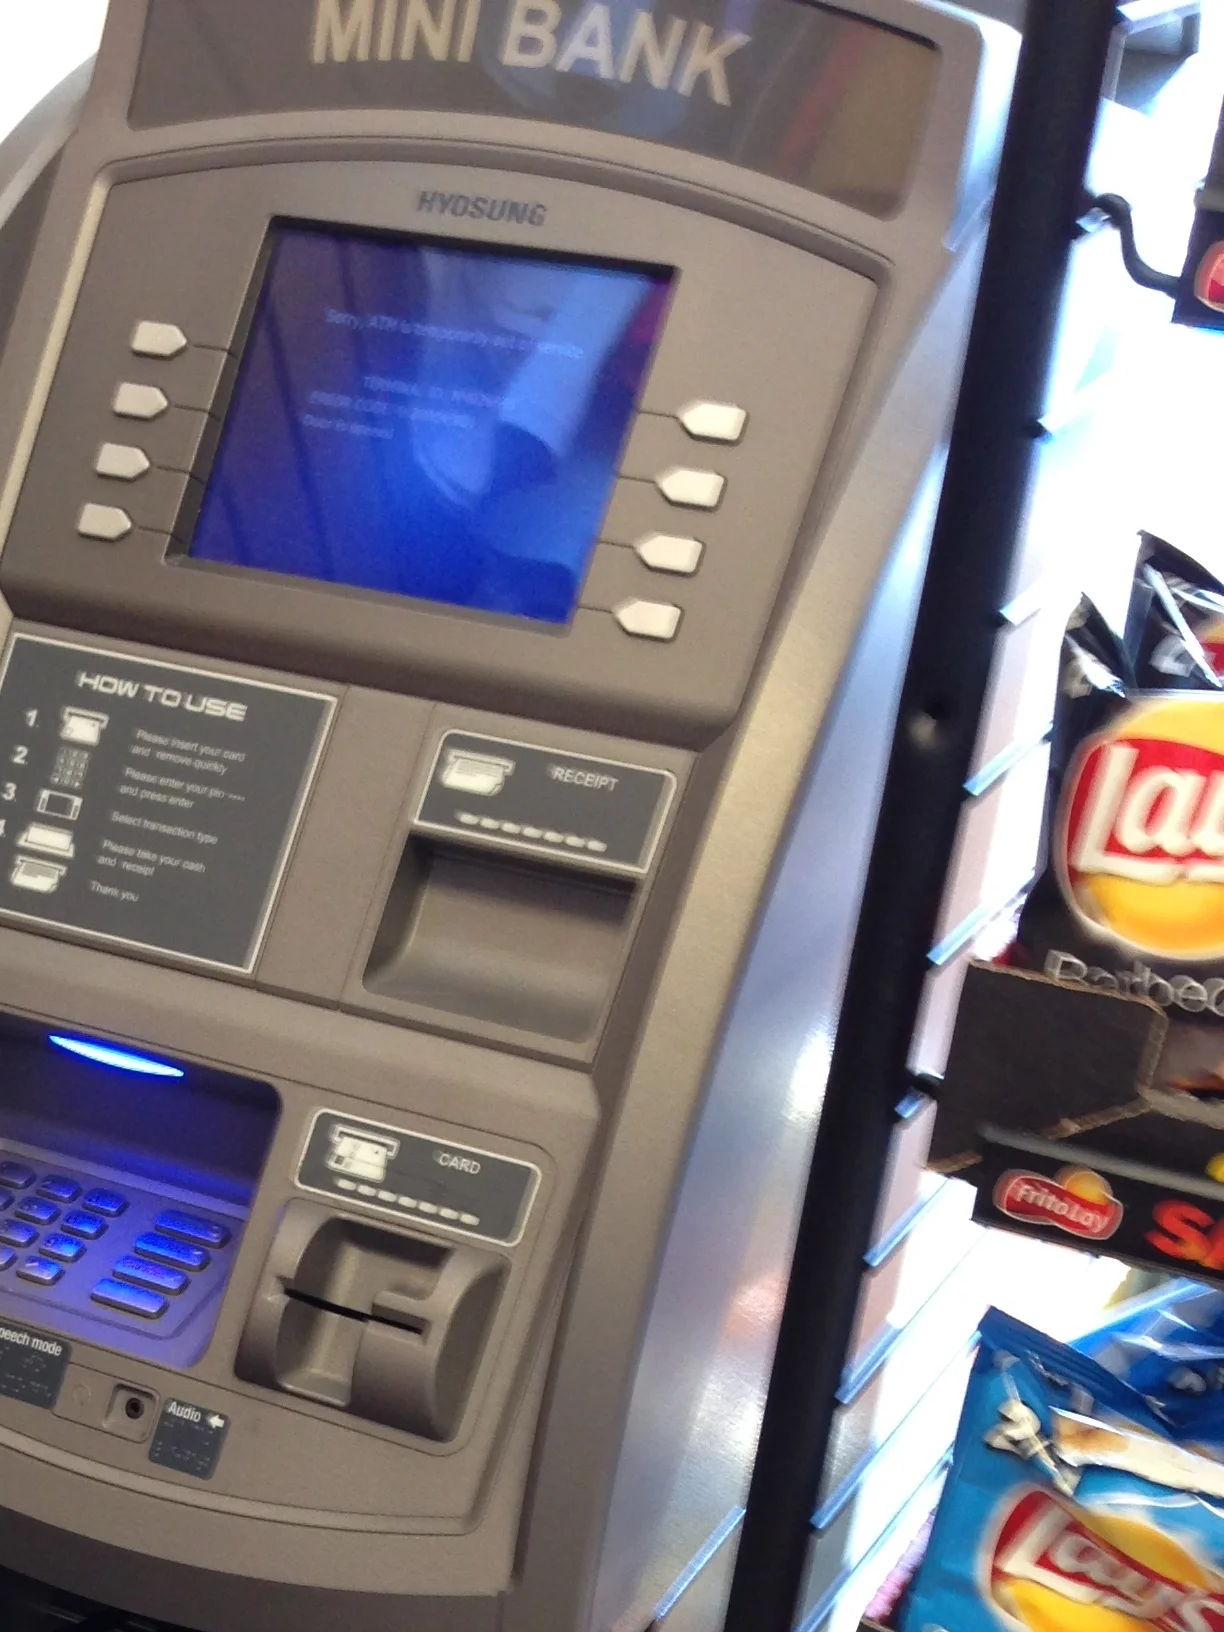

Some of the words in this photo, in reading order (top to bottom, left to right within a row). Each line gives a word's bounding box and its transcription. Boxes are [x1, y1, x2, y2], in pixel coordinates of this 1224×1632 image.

[311, 0, 479, 64] MINI
[502, 0, 752, 107] BANK
[417, 189, 548, 228] HYOSUNG
[78, 671, 140, 699] HOW
[144, 684, 182, 708] TO
[184, 693, 248, 722] USE
[552, 765, 619, 792] RECEIPT
[111, 810, 142, 827] Select
[90, 879, 120, 897] Thank
[120, 890, 140, 903] you
[437, 1152, 481, 1175] CARD
[31, 1337, 63, 1357] mode
[168, 1401, 202, 1422] Audio
